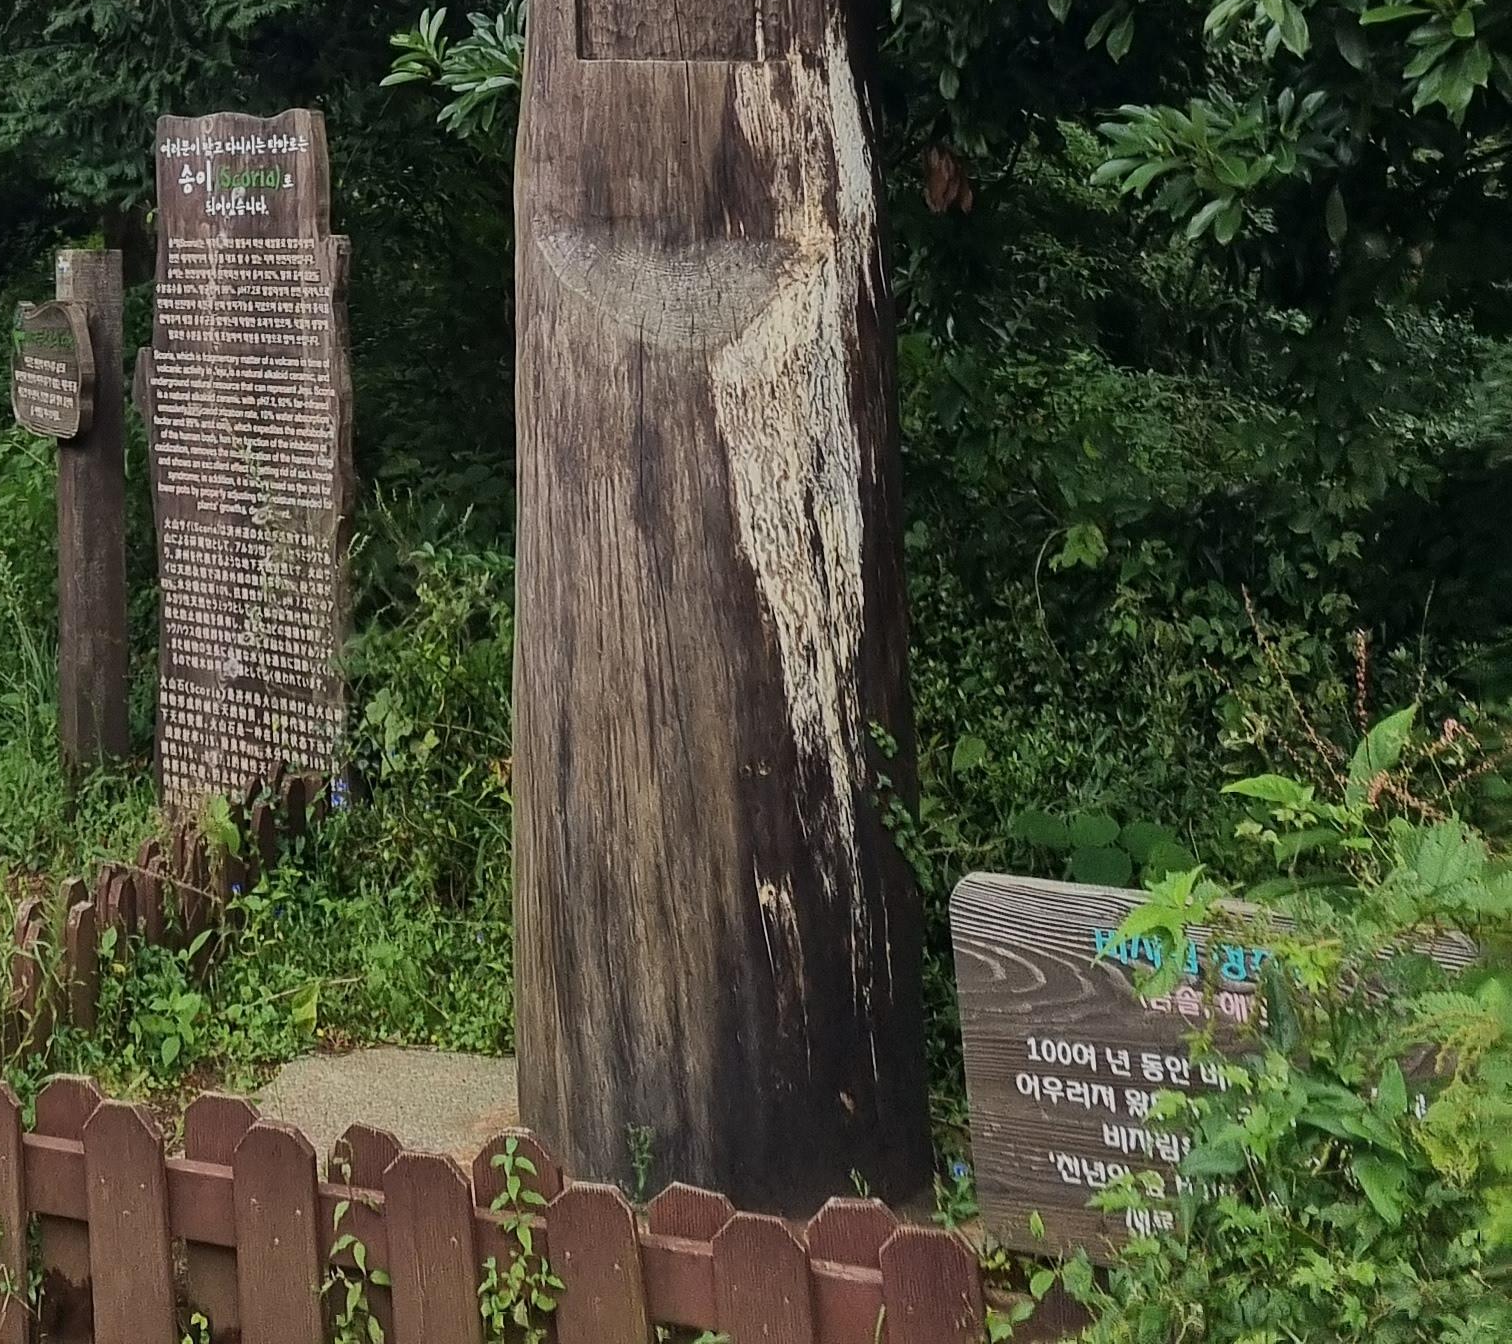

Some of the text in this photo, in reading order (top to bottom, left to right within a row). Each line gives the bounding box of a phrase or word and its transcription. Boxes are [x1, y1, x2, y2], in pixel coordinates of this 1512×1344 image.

[178, 160, 213, 194] 송이
[1025, 1035, 1096, 1072] 100여
[1105, 1046, 1132, 1078] 년
[1141, 1051, 1191, 1086] 동안
